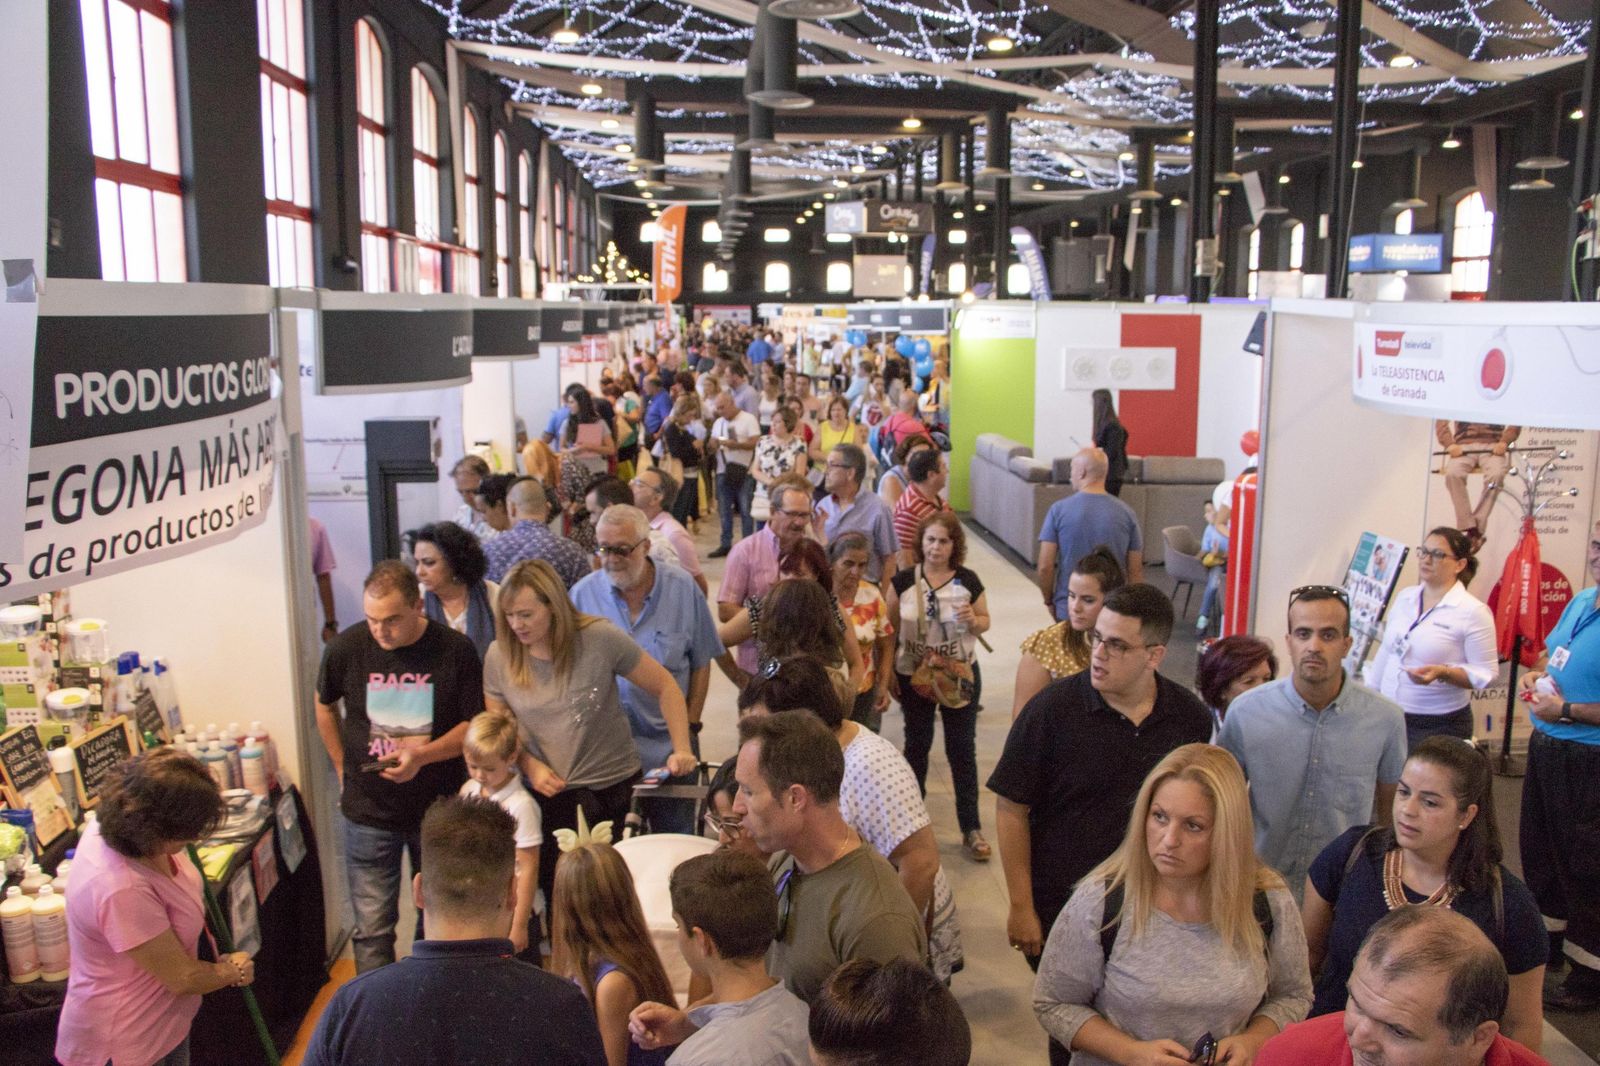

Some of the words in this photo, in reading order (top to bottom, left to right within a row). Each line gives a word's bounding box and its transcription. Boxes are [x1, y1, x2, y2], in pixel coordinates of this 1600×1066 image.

[660, 223, 678, 289] STIHL
[55, 361, 240, 419] PRODUCTOS
[1378, 365, 1446, 383] TELEASISTENCIA
[1381, 384, 1390, 396] de
[1392, 385, 1427, 401] Granada
[199, 419, 249, 491] MÁS
[29, 543, 76, 580] de
[86, 504, 235, 577] productos
[237, 491, 255, 521] de
[1553, 578, 1569, 590] de
[368, 672, 432, 692] BACK
